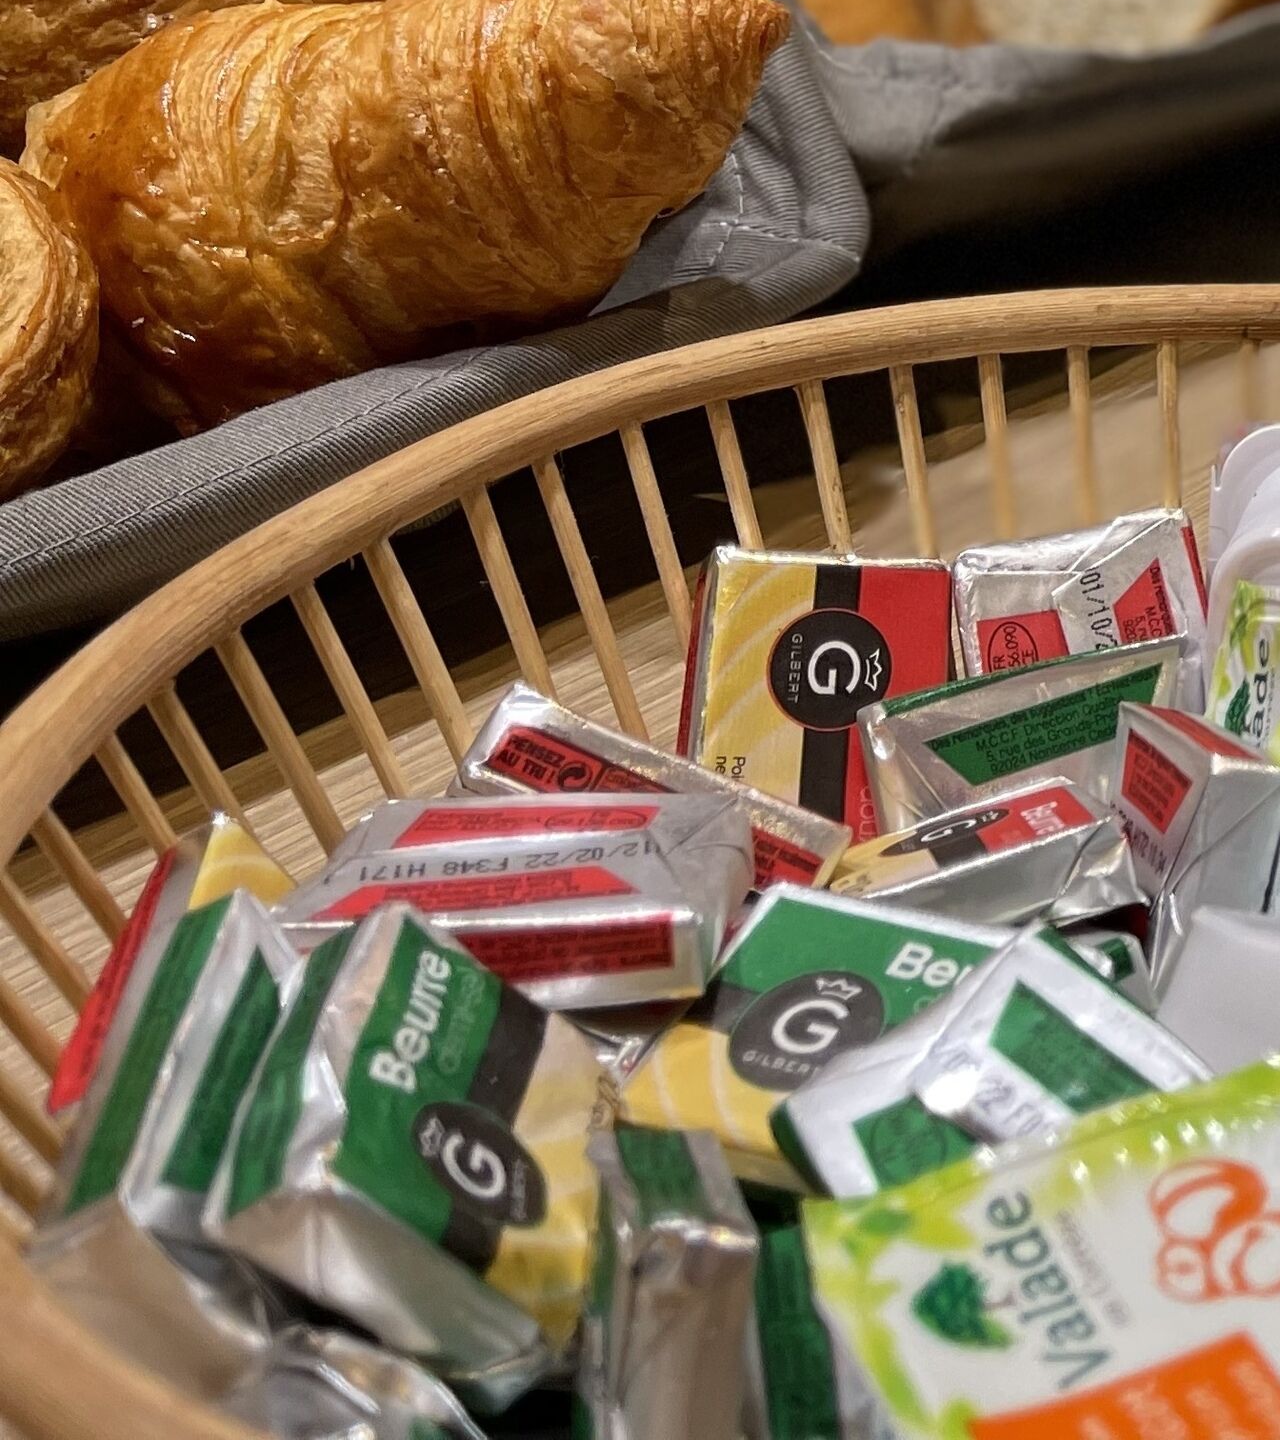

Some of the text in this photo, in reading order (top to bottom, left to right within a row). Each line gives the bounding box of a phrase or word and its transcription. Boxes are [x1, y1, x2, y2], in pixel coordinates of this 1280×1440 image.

[786, 632, 804, 704] GILBERT
[807, 639, 861, 695] G
[1022, 708, 1080, 735] Direction
[496, 748, 521, 767] AU
[441, 857, 510, 876] F348
[368, 949, 452, 1093] Beurre
[770, 998, 850, 1055] G
[442, 1130, 507, 1199] G
[983, 1190, 1111, 1389] Valade
